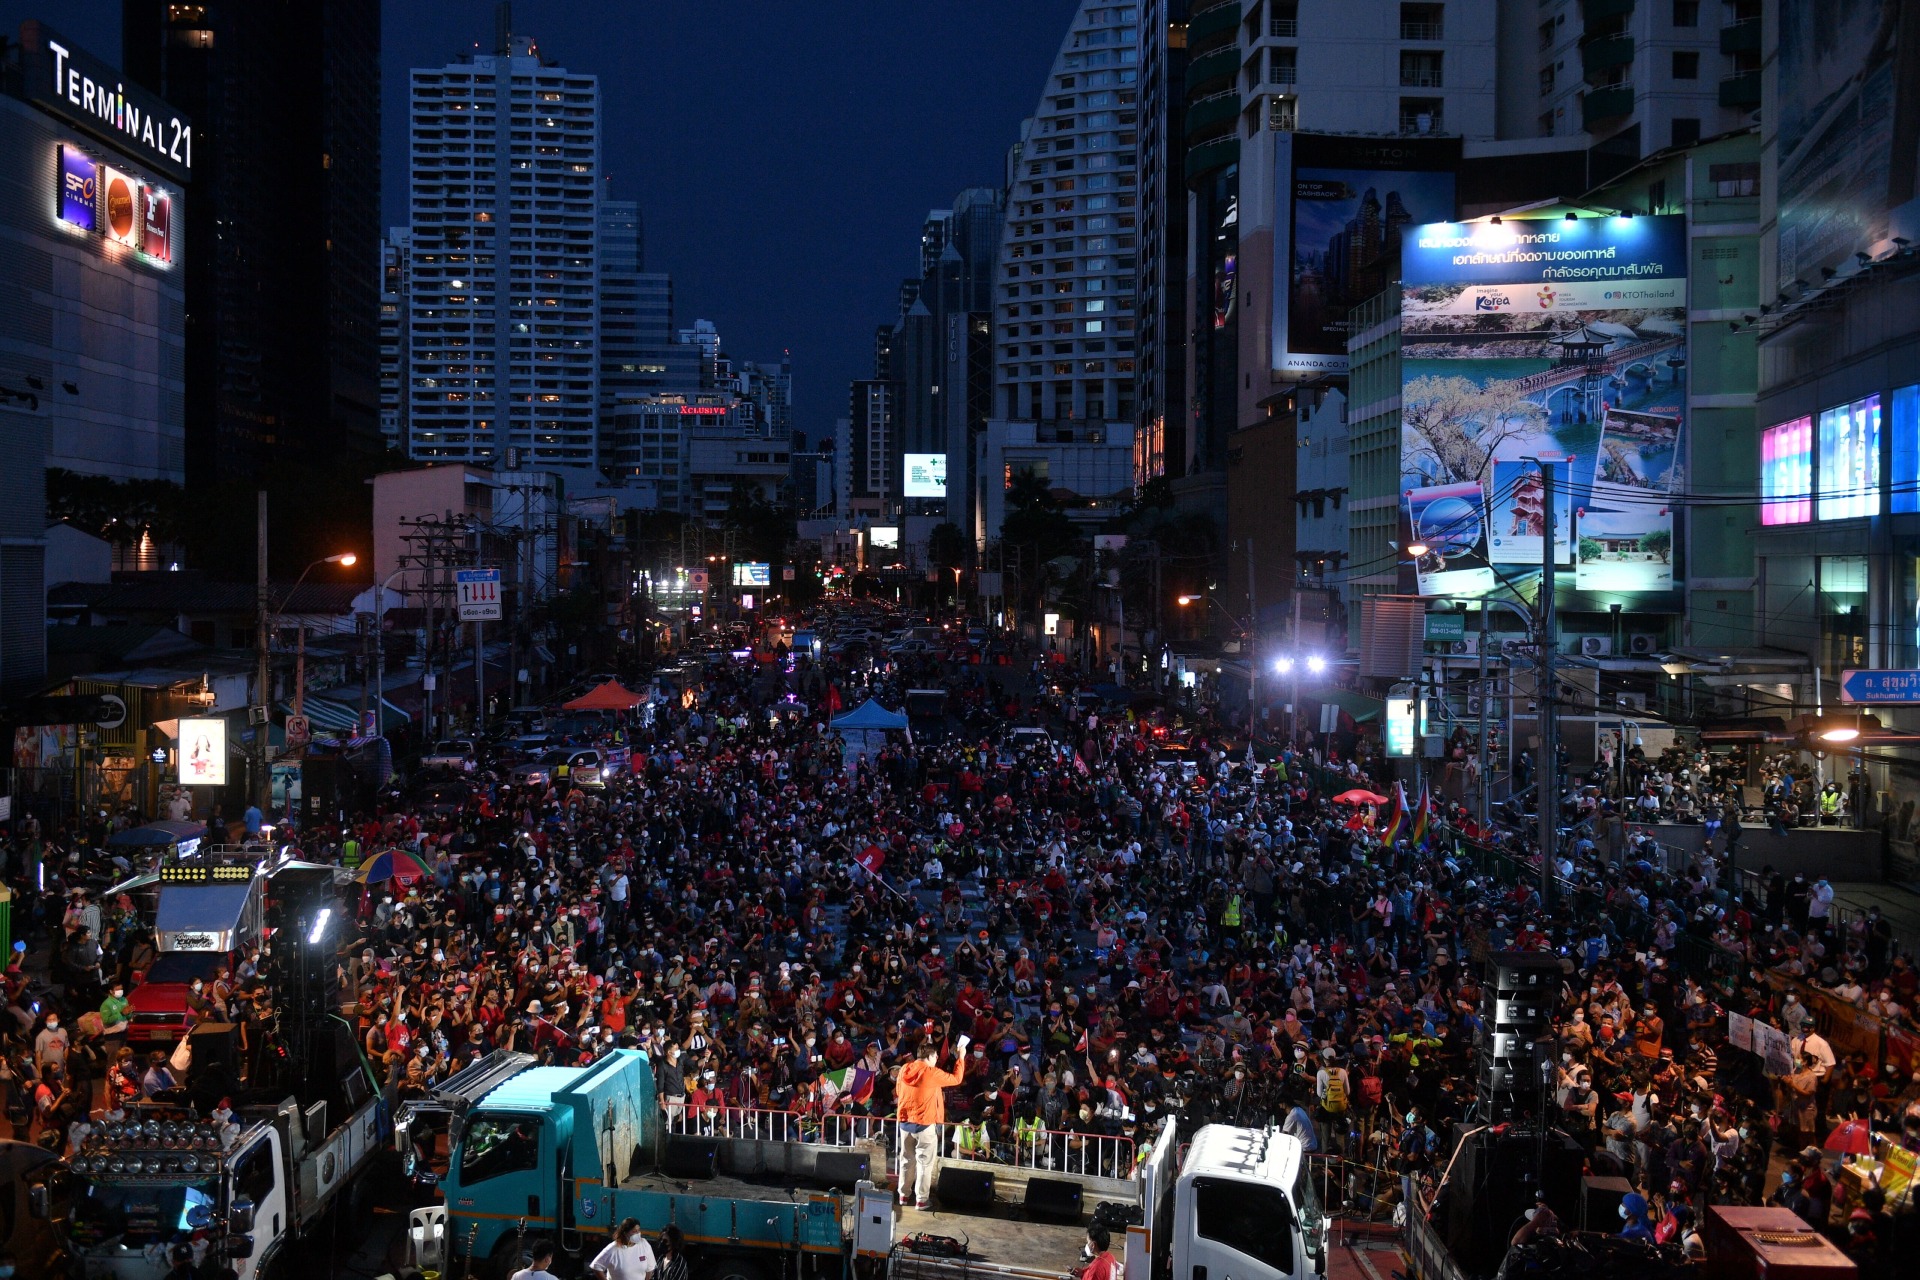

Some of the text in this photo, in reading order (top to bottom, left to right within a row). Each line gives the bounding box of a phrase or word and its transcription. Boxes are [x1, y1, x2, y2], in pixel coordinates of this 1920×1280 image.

[170, 117, 191, 168] 21
[65, 191, 94, 208] CINEMA
[1622, 289, 1675, 299] KTOThailand
[1476, 295, 1510, 311] Korea
[1882, 673, 1920, 692] สุขุมวิ
